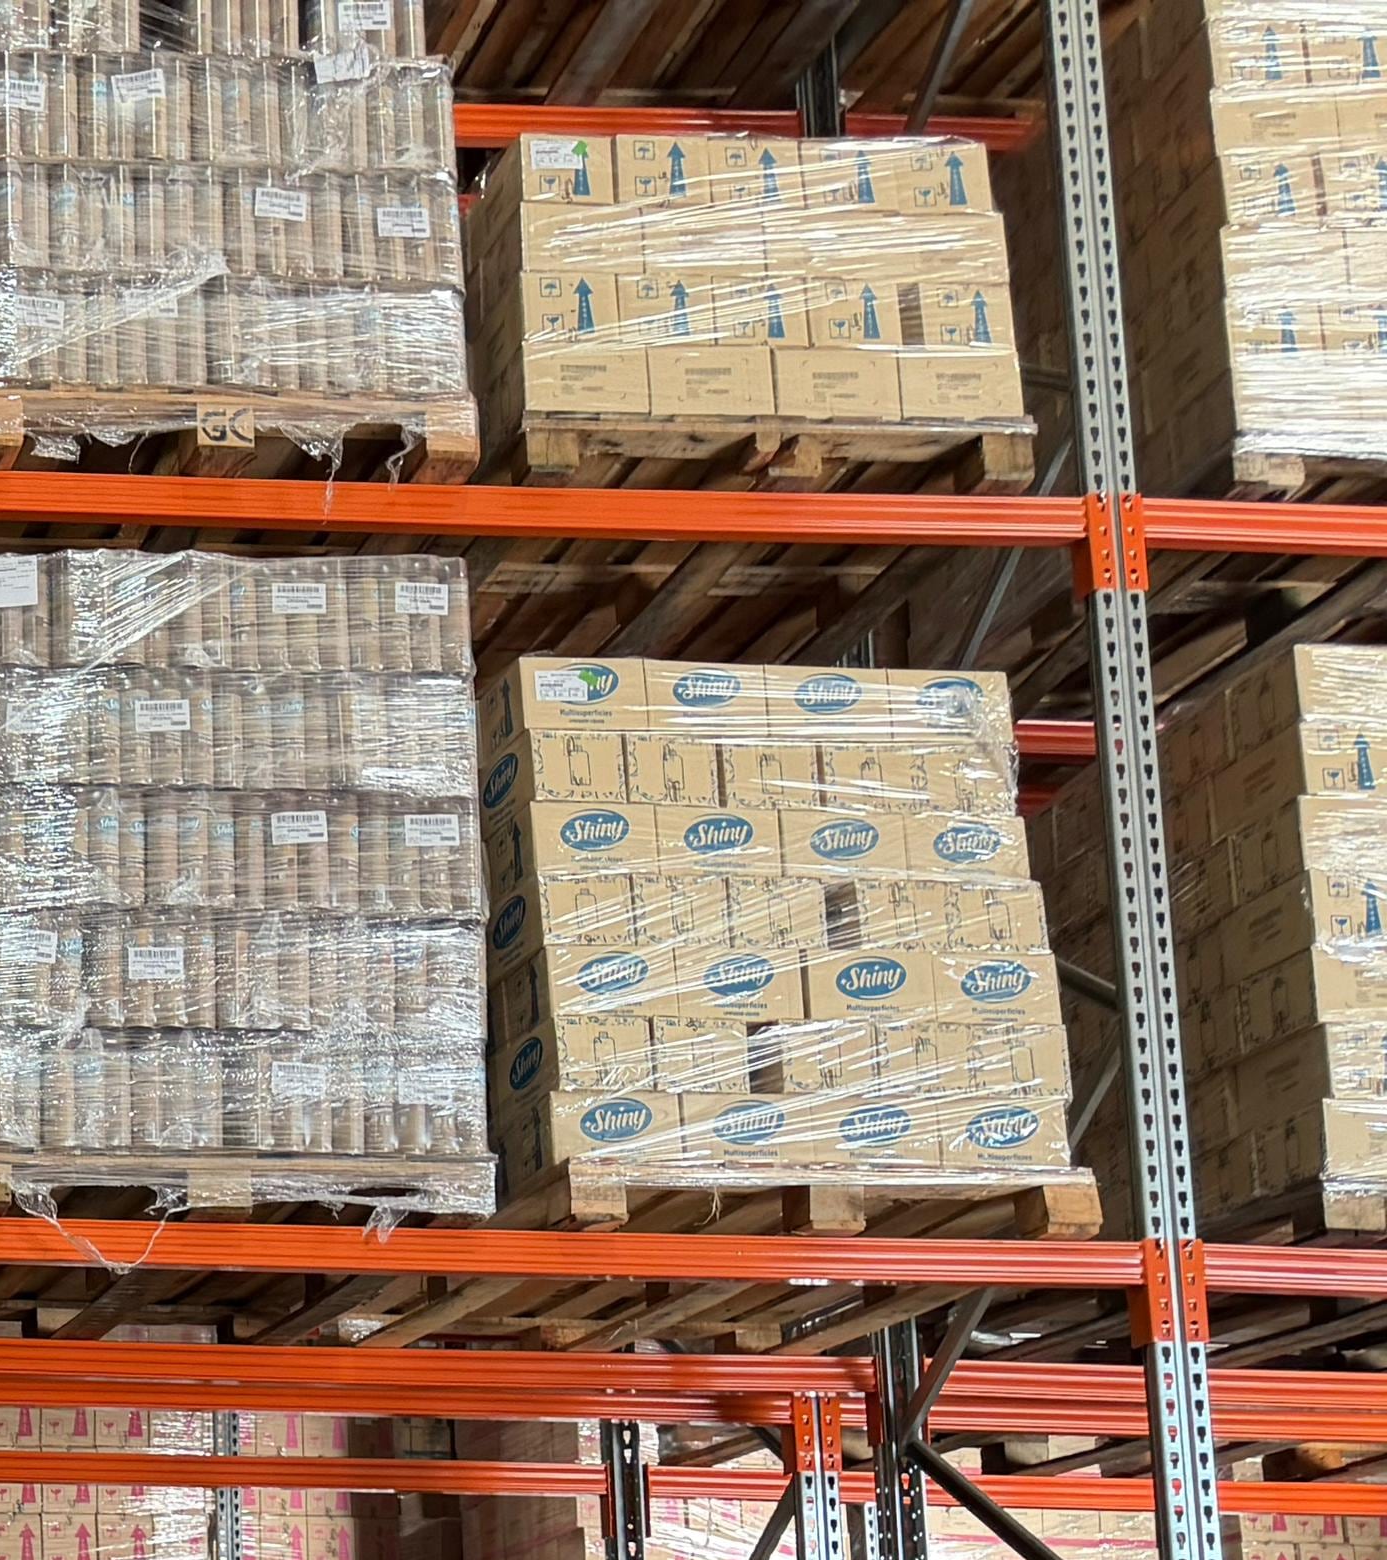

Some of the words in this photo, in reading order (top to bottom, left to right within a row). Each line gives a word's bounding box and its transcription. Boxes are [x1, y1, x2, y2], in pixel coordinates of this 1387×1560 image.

[678, 676, 736, 704] Shiny
[486, 760, 518, 801] Shiny
[567, 813, 626, 847] Shiny
[690, 816, 751, 851] Shiny
[814, 820, 875, 856] Shiny
[494, 901, 526, 945] Shiny
[842, 961, 906, 997] Shiny
[968, 966, 1029, 1000] Shiny
[509, 1043, 543, 1085] Shiny
[585, 1103, 649, 1138] Shiny
[847, 1107, 908, 1143] Shiny
